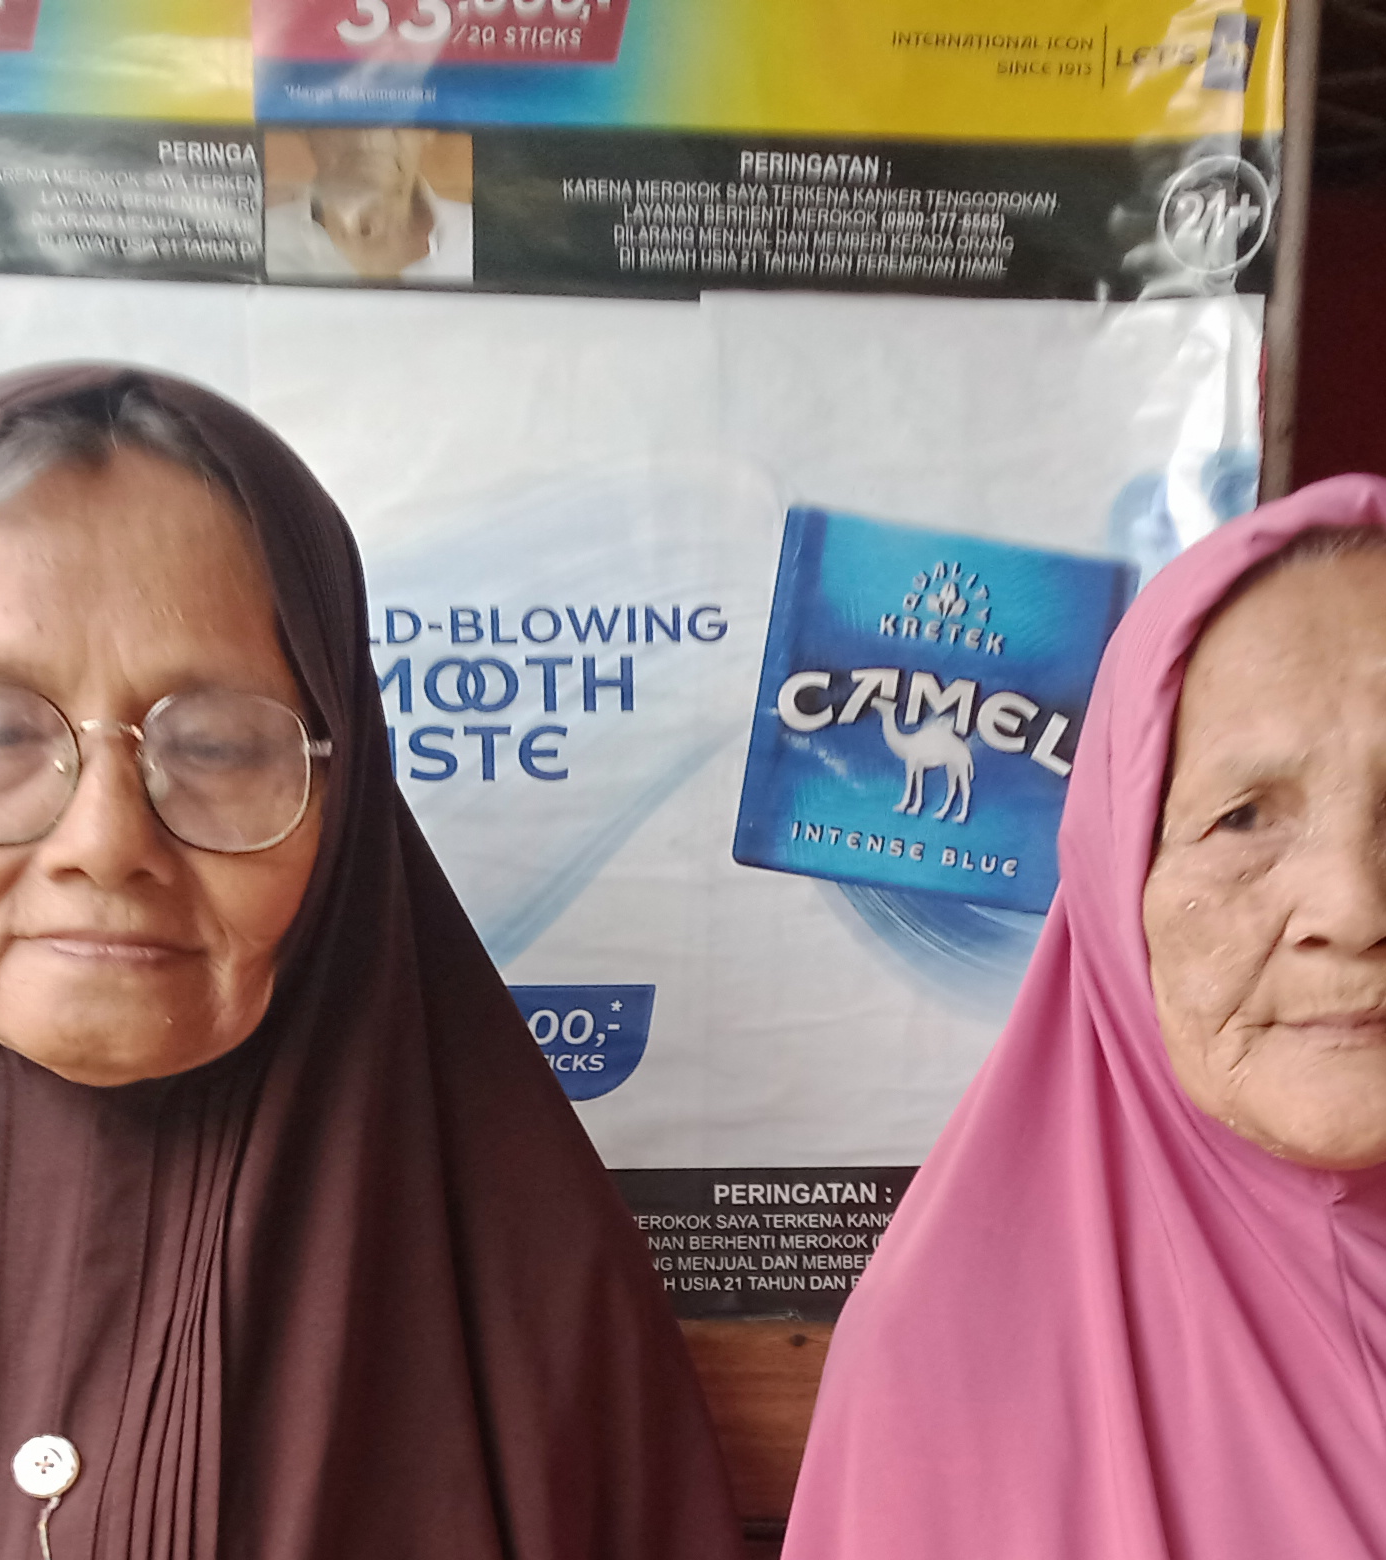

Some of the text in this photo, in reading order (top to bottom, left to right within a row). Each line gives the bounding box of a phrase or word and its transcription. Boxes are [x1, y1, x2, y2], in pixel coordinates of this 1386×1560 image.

[453, 24, 583, 48] /20 STICKS
[892, 31, 1094, 51] INTERNATIONAL ICON
[997, 59, 1052, 76] SINCE
[740, 151, 879, 182] PERINGATAN
[563, 177, 1058, 215] KARENA MEROKOK SAYA TERKENA KANKER TENGGOROKAN
[624, 202, 699, 226] LAYANAN
[704, 204, 788, 229] BERHENTI
[793, 206, 877, 231] MEROKOK
[1175, 188, 1261, 238] 21+
[614, 224, 1015, 257] DILARANG MENJUAL DAN MEMBERI KEPADA ORANG
[619, 247, 1008, 278] DI BAWAH USIA 21 TAHUN DAN PEREMPUAN HAMIL
[879, 613, 1006, 657] KRETEK
[777, 667, 1074, 779] CAMEL
[387, 724, 570, 782] STE
[791, 821, 1019, 878] INTENSE BLUE
[713, 1182, 878, 1206] PERINGATAN
[632, 1213, 712, 1231] EROKOK
[715, 1213, 760, 1231] SAYA
[762, 1212, 844, 1230] TERKENA
[689, 1235, 776, 1251] BERHENTI
[779, 1233, 869, 1250] MEROKOK
[677, 1255, 759, 1272] MENJUAL
[761, 1255, 798, 1271] DAN
[681, 1276, 722, 1292] USIA
[724, 1276, 743, 1291] 21
[748, 1276, 806, 1291] TAHUN
[810, 1275, 847, 1291] DAN
